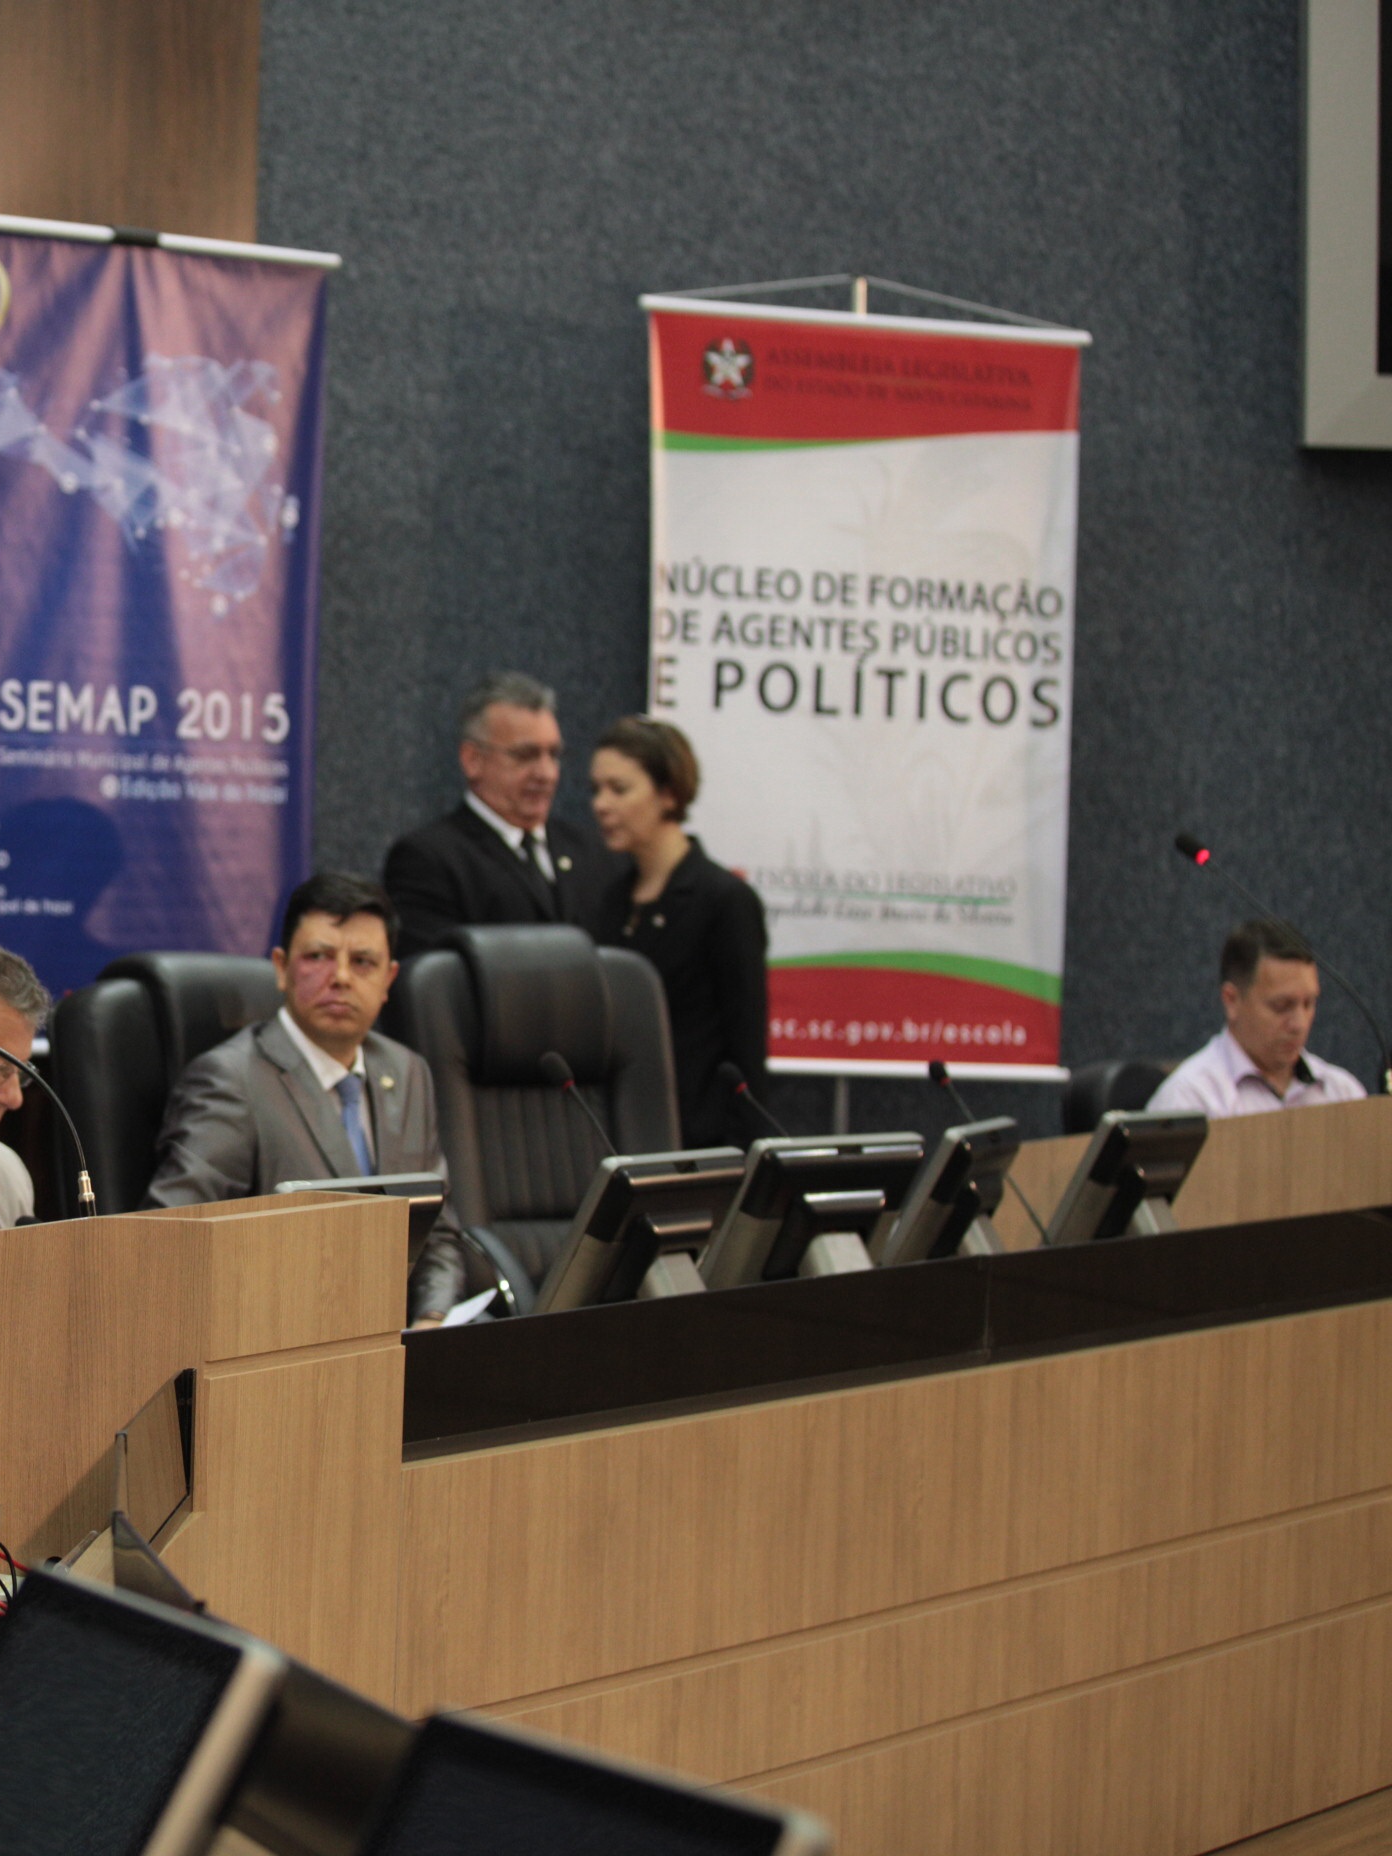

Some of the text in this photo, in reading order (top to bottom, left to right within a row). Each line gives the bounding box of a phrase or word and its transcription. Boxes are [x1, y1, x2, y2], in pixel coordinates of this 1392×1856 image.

[657, 556, 1063, 621] NÚCLEO DE FORMAÇÃO
[656, 608, 1062, 666] DE AGENTES PÚBLICOS
[177, 688, 290, 743] 2015
[654, 648, 1060, 729] E POLÍTICOS
[152, 752, 170, 771] de
